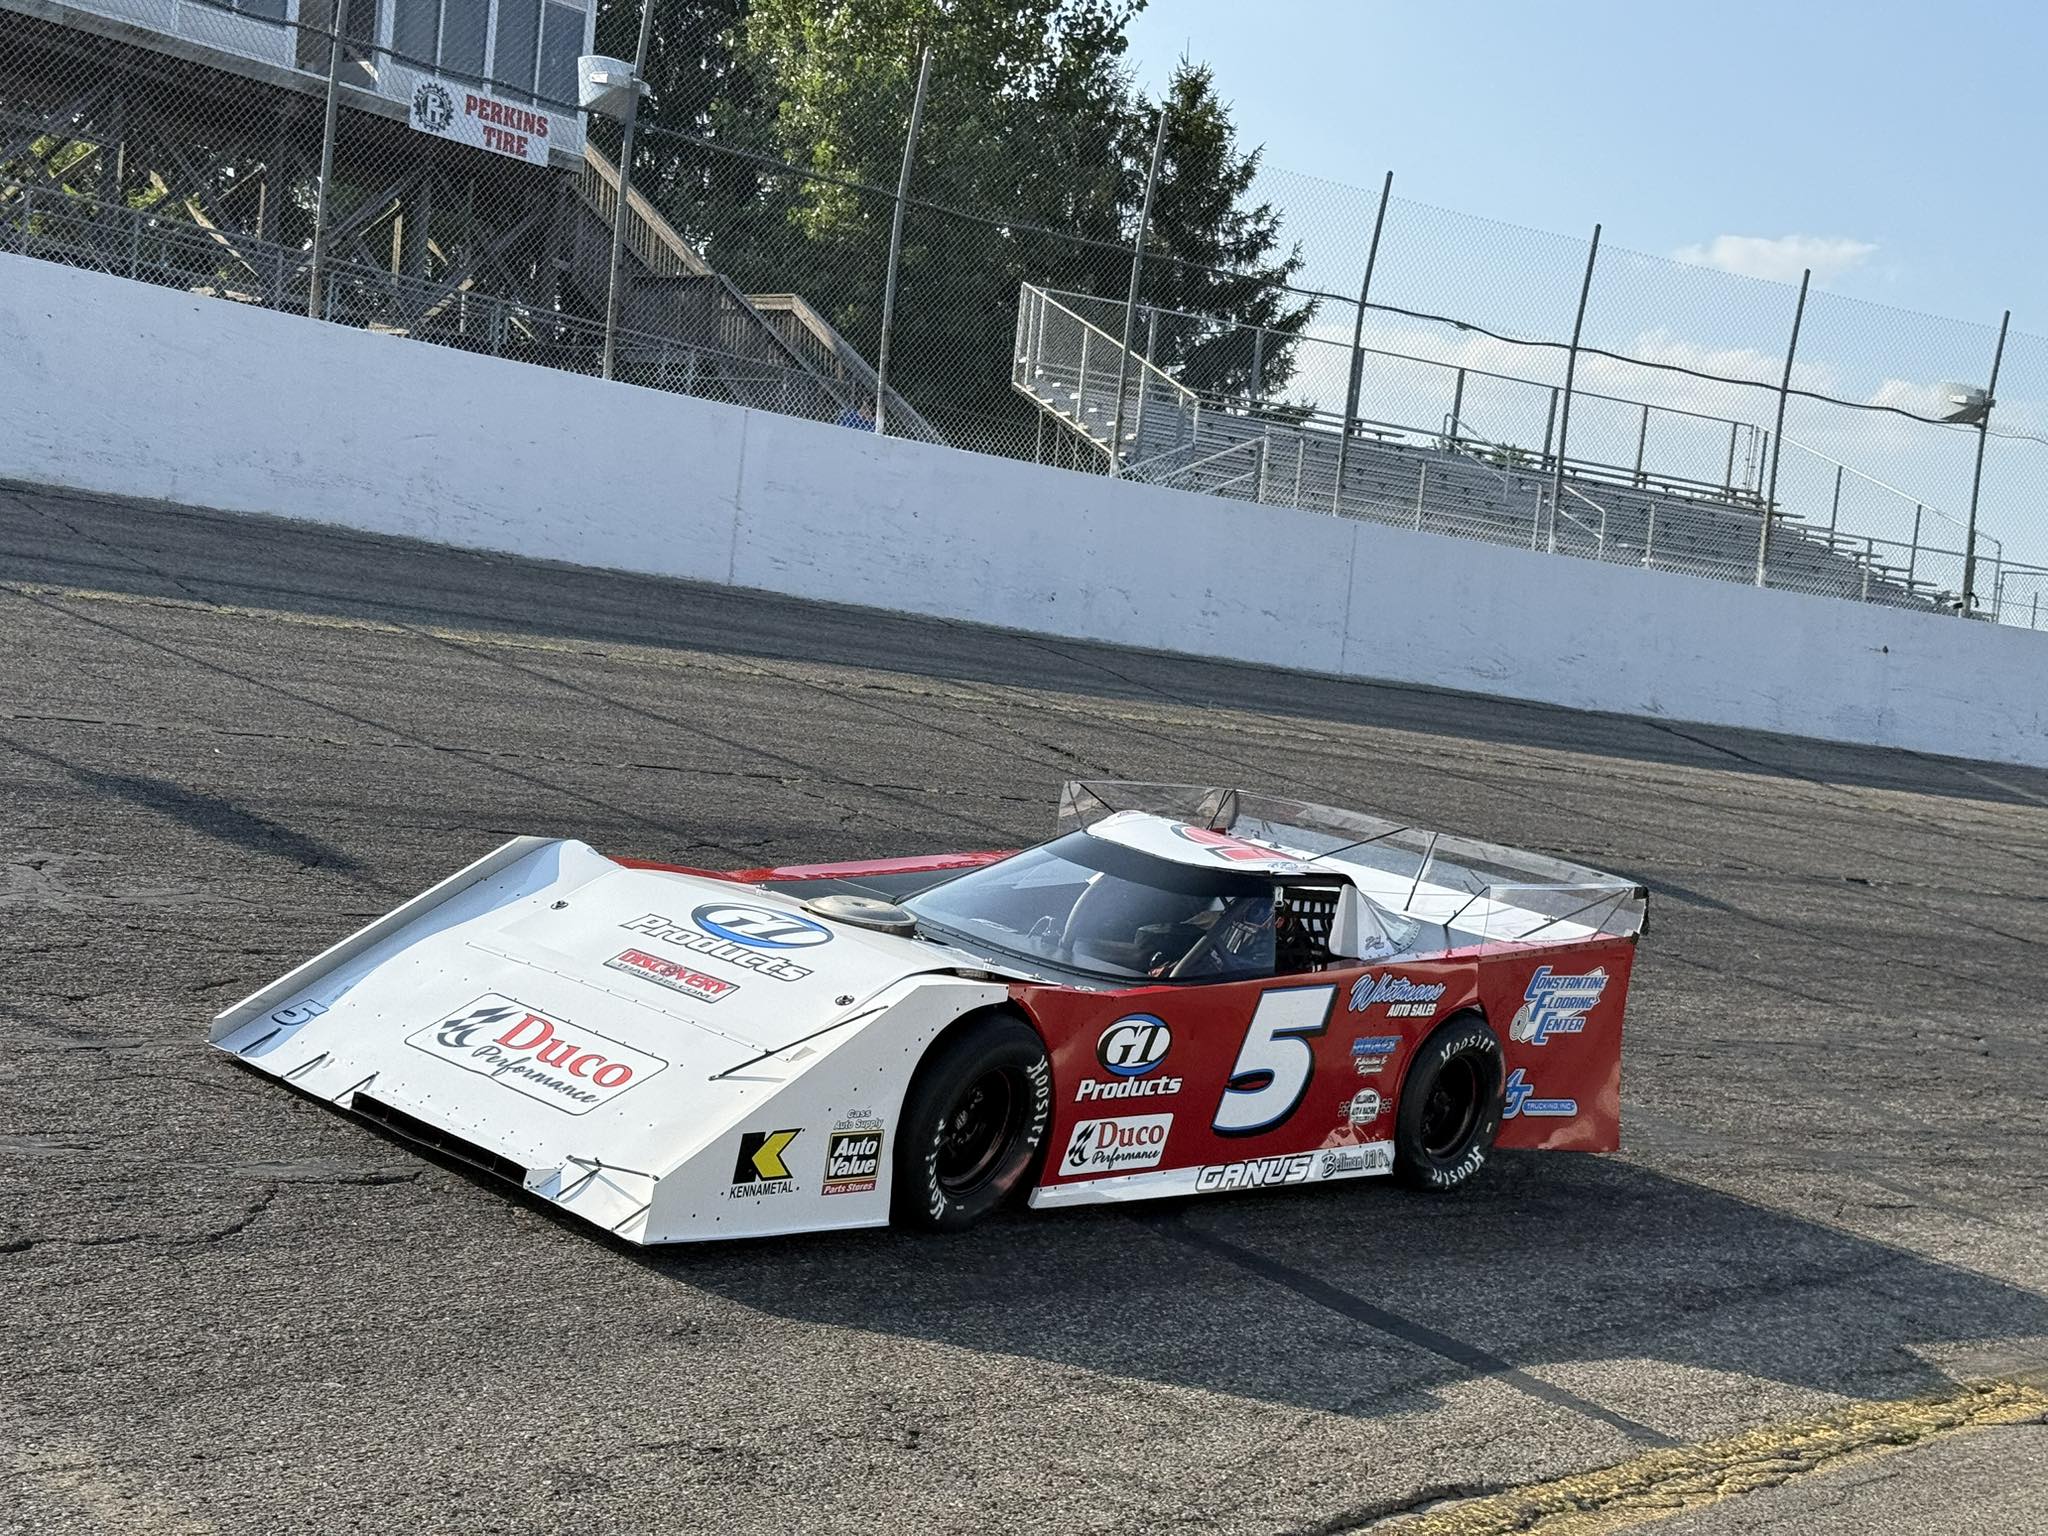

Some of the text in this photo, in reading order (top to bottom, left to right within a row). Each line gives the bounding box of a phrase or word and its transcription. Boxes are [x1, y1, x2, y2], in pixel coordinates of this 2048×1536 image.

[465, 94, 548, 138] PERKINS
[483, 125, 528, 158] TIRE
[618, 913, 814, 982] Products
[618, 951, 733, 994] DISCOVERY
[1525, 965, 1609, 1000] CONSTANTINE
[1386, 1003, 1437, 1017] AUTO SALES
[1530, 990, 1598, 1023] FLOORING
[1532, 1011, 1587, 1045] CENTER
[492, 1012, 634, 1088] Duco
[1211, 984, 1338, 1138] 5
[471, 1045, 600, 1103] Performance
[1074, 1076, 1183, 1102] Products
[833, 1136, 878, 1157] Auto
[1095, 1121, 1164, 1149] Duco
[828, 1155, 877, 1177] Value
[1091, 1147, 1160, 1169] Performance
[1196, 1154, 1314, 1192] GANUS
[729, 1181, 793, 1200] KENNAMETAL
[824, 1185, 847, 1194] Parts
